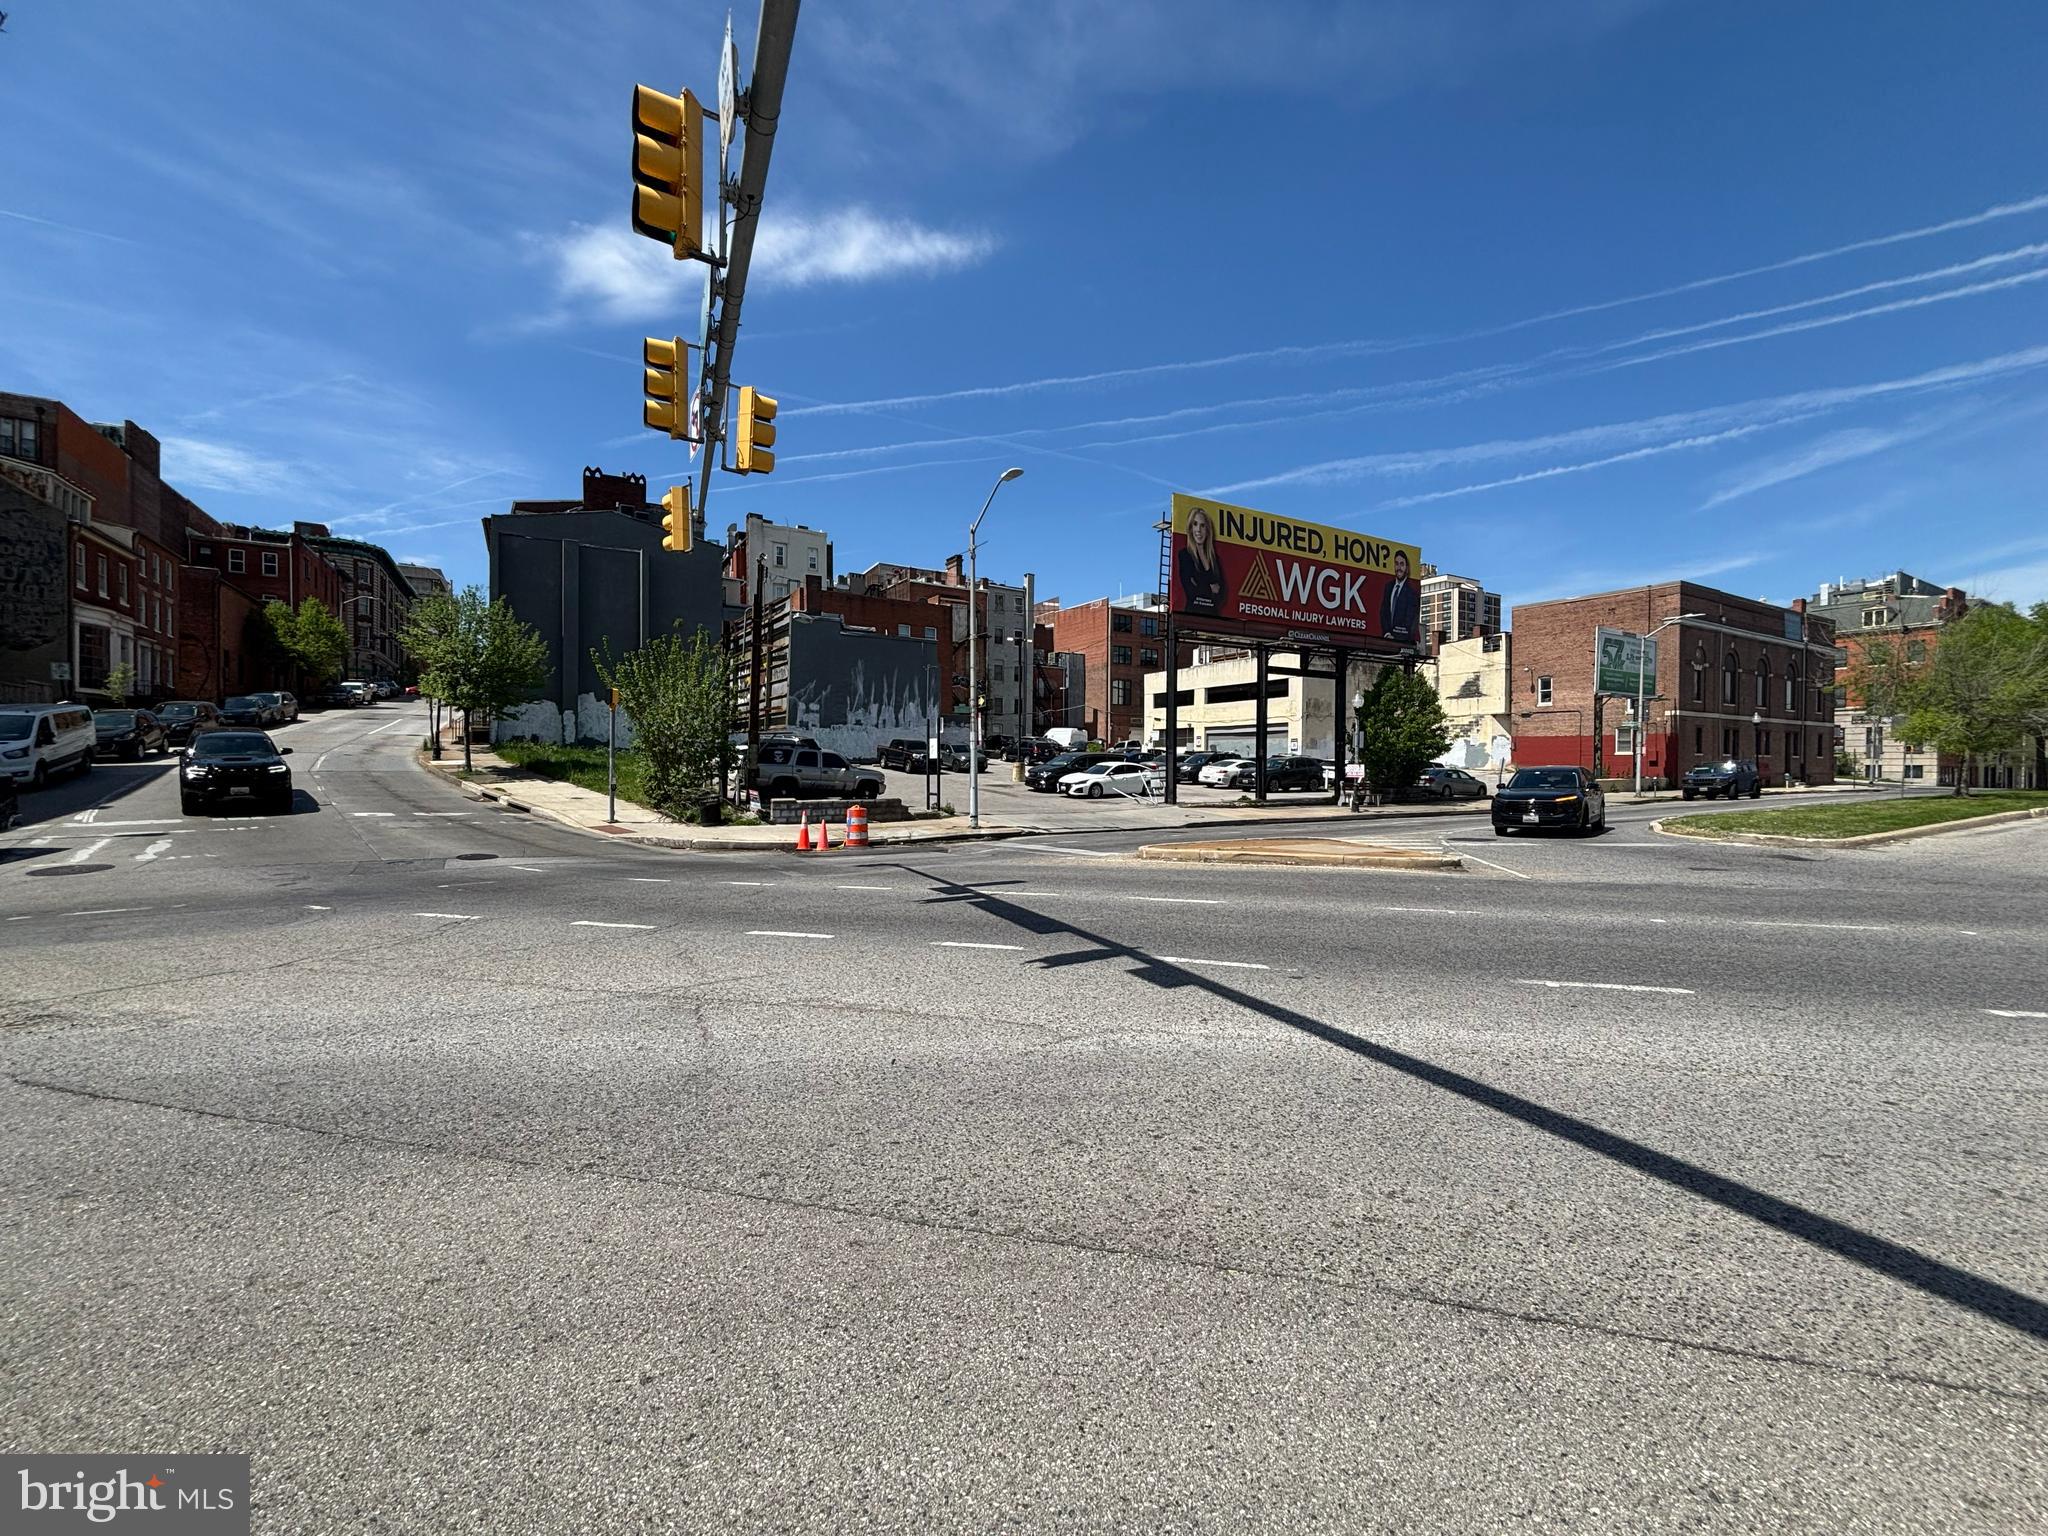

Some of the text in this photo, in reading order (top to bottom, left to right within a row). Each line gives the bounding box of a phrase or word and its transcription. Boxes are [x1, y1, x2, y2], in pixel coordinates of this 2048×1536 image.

[1218, 509, 1391, 568] INJURED, HON?
[1275, 558, 1367, 613] WGK
[1239, 602, 1367, 630] PERSONAL INJURY LAWYERS
